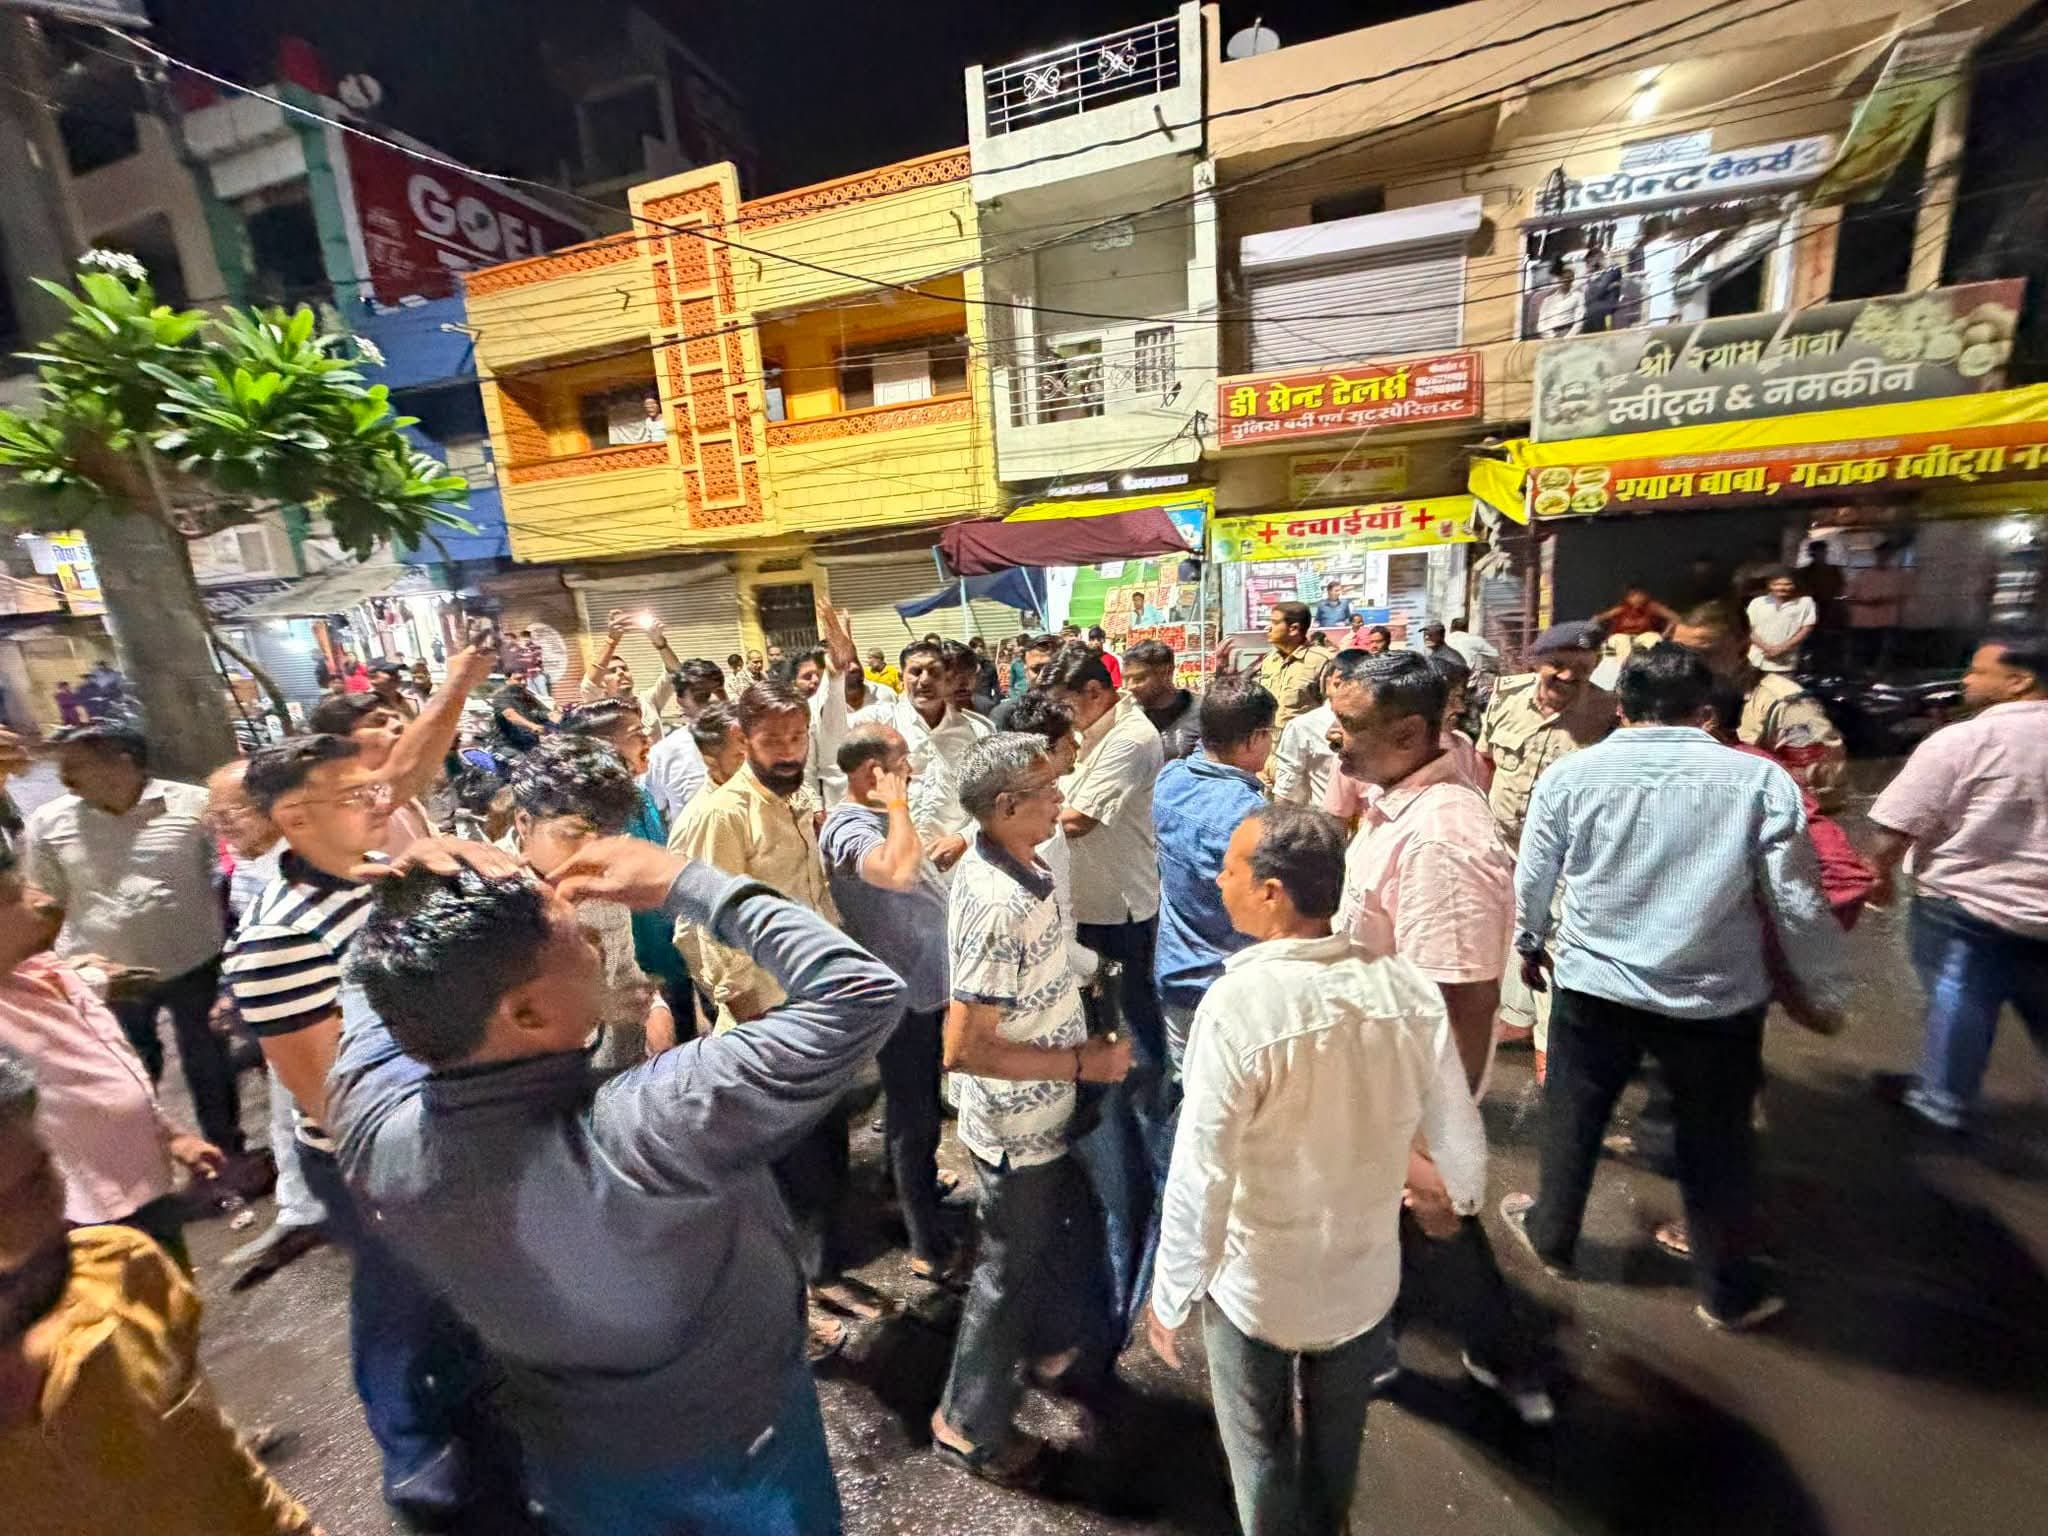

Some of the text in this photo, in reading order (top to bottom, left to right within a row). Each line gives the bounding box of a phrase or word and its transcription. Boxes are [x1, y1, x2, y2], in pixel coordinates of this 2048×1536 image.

[1229, 386, 1260, 418] डी
[1606, 383, 1721, 426] स्वीट्स
[1723, 383, 1757, 412] &
[1763, 356, 1923, 405] नमकीन
[1615, 473, 1697, 502] श्याम
